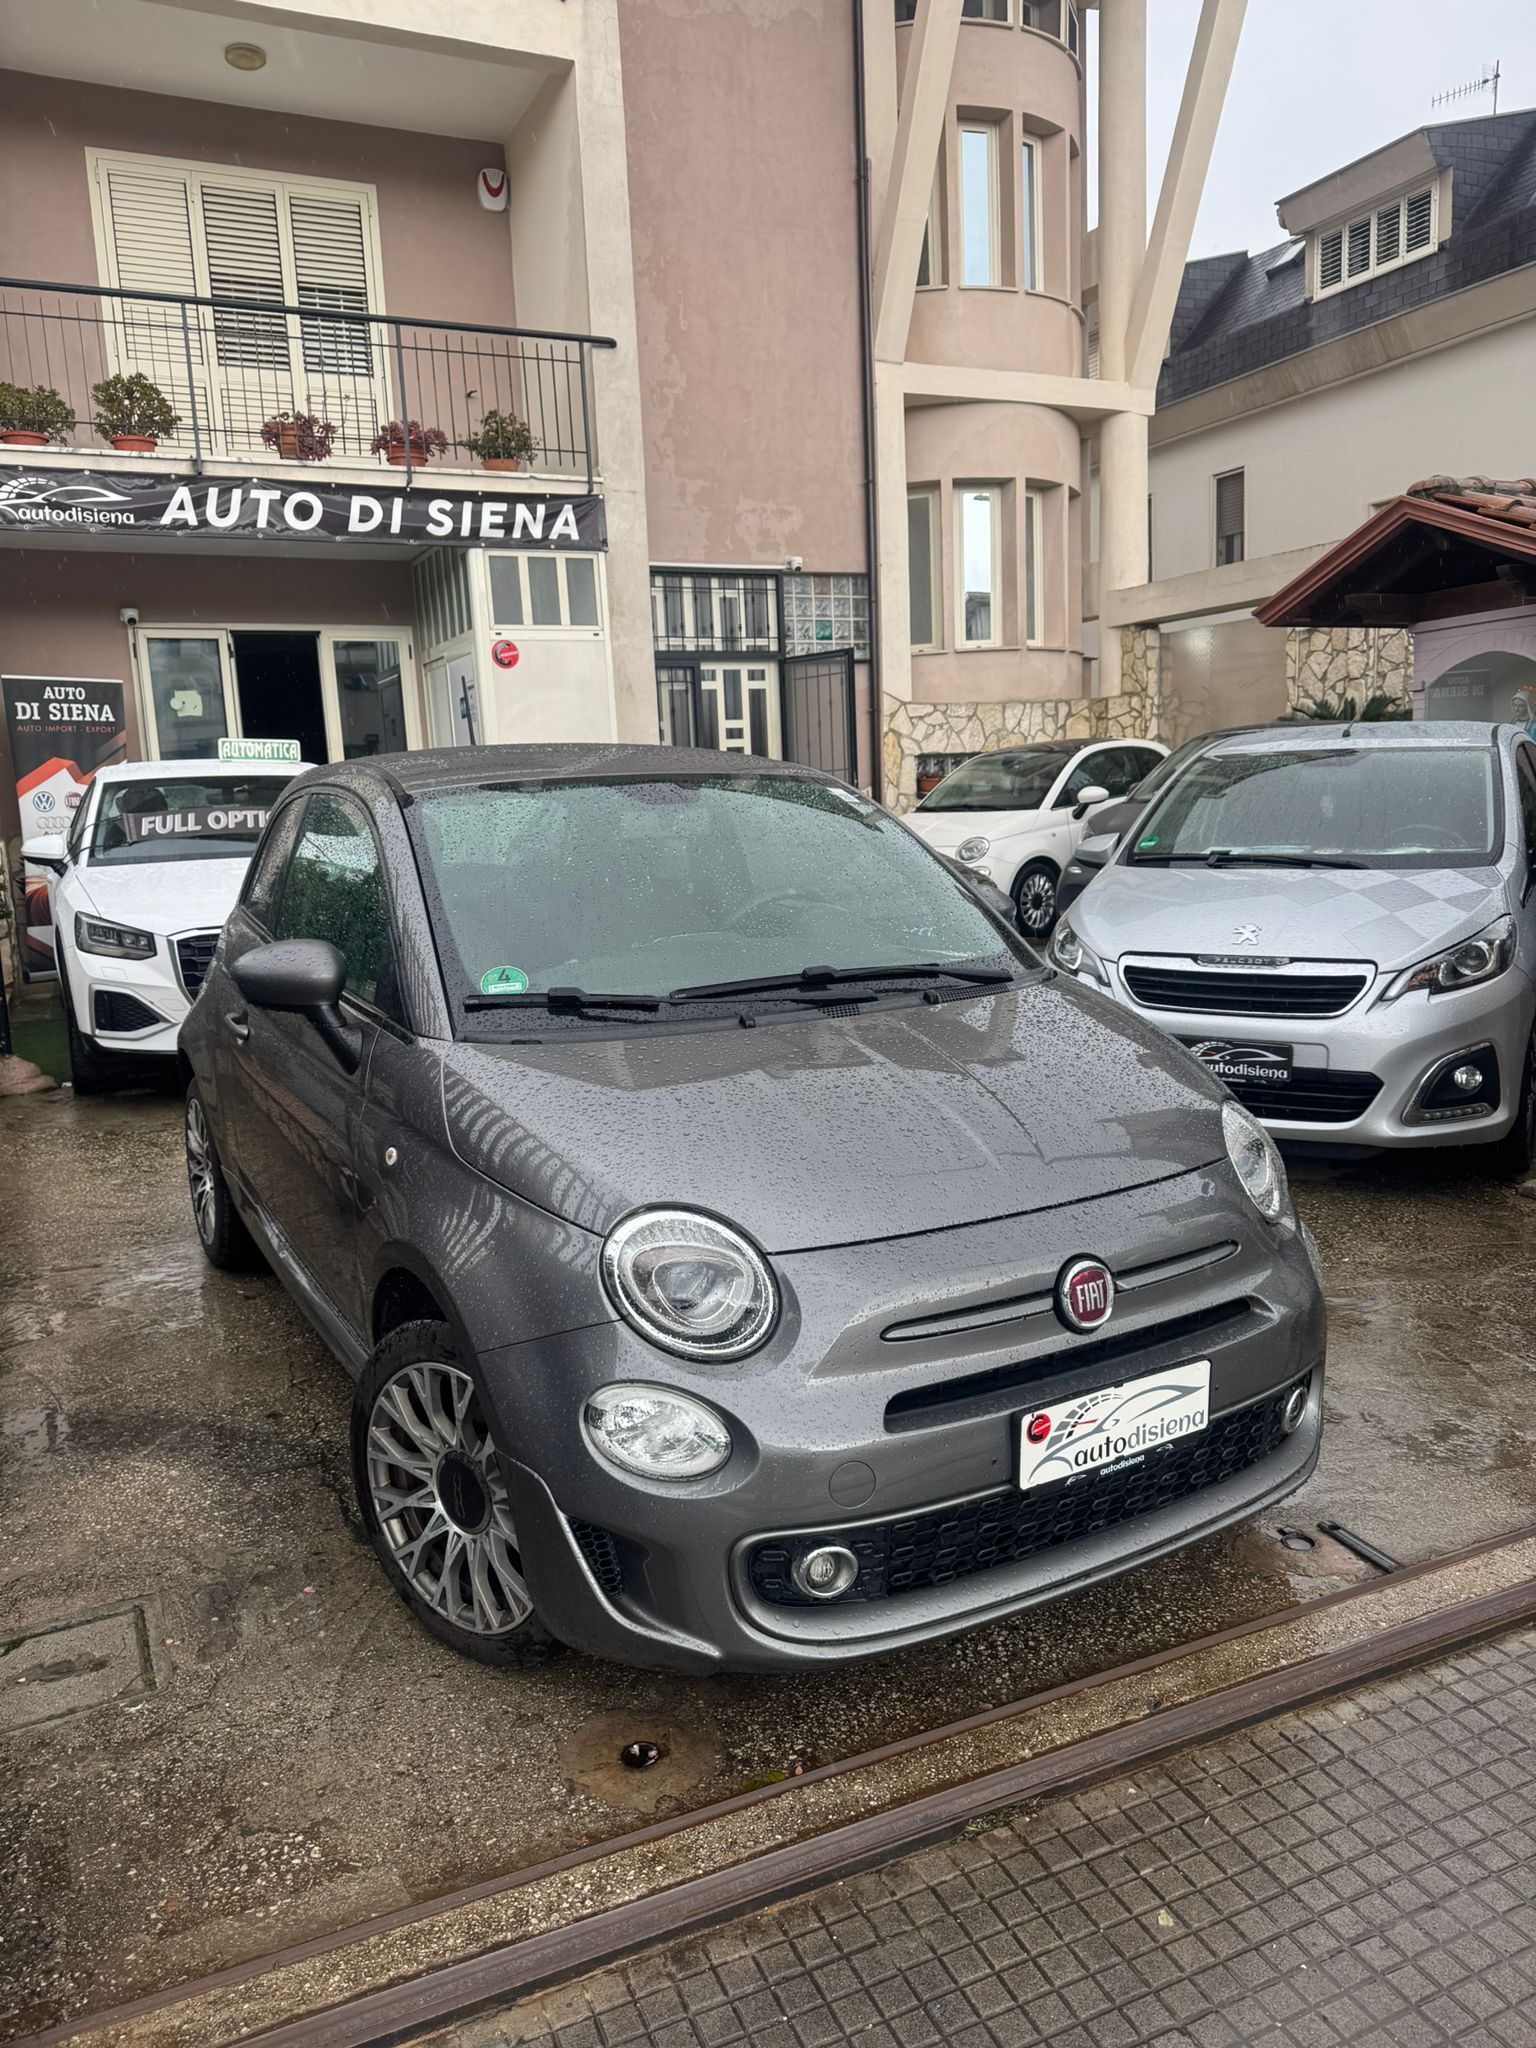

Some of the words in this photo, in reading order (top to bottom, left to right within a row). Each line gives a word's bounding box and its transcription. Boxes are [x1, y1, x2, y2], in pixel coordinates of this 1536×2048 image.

[18, 505, 135, 525] autodisiena
[160, 486, 324, 531] AUTO
[347, 495, 404, 534] DI
[425, 499, 580, 541] SIENA
[43, 686, 86, 700] AUTO
[14, 702, 41, 720] DI
[48, 702, 116, 722] SIENA
[17, 724, 42, 733] AUTO
[45, 725, 77, 734] IMPORT
[86, 726, 116, 734] EXPORT
[223, 741, 298, 759] AUTOMATICA
[140, 812, 202, 836] FULL
[498, 968, 511, 983] 4
[1206, 1062, 1288, 1079] utodisiena
[1075, 1278, 1105, 1314] FIAT
[1074, 1409, 1205, 1467] autodisiena
[1100, 1455, 1144, 1475] autodisiena
